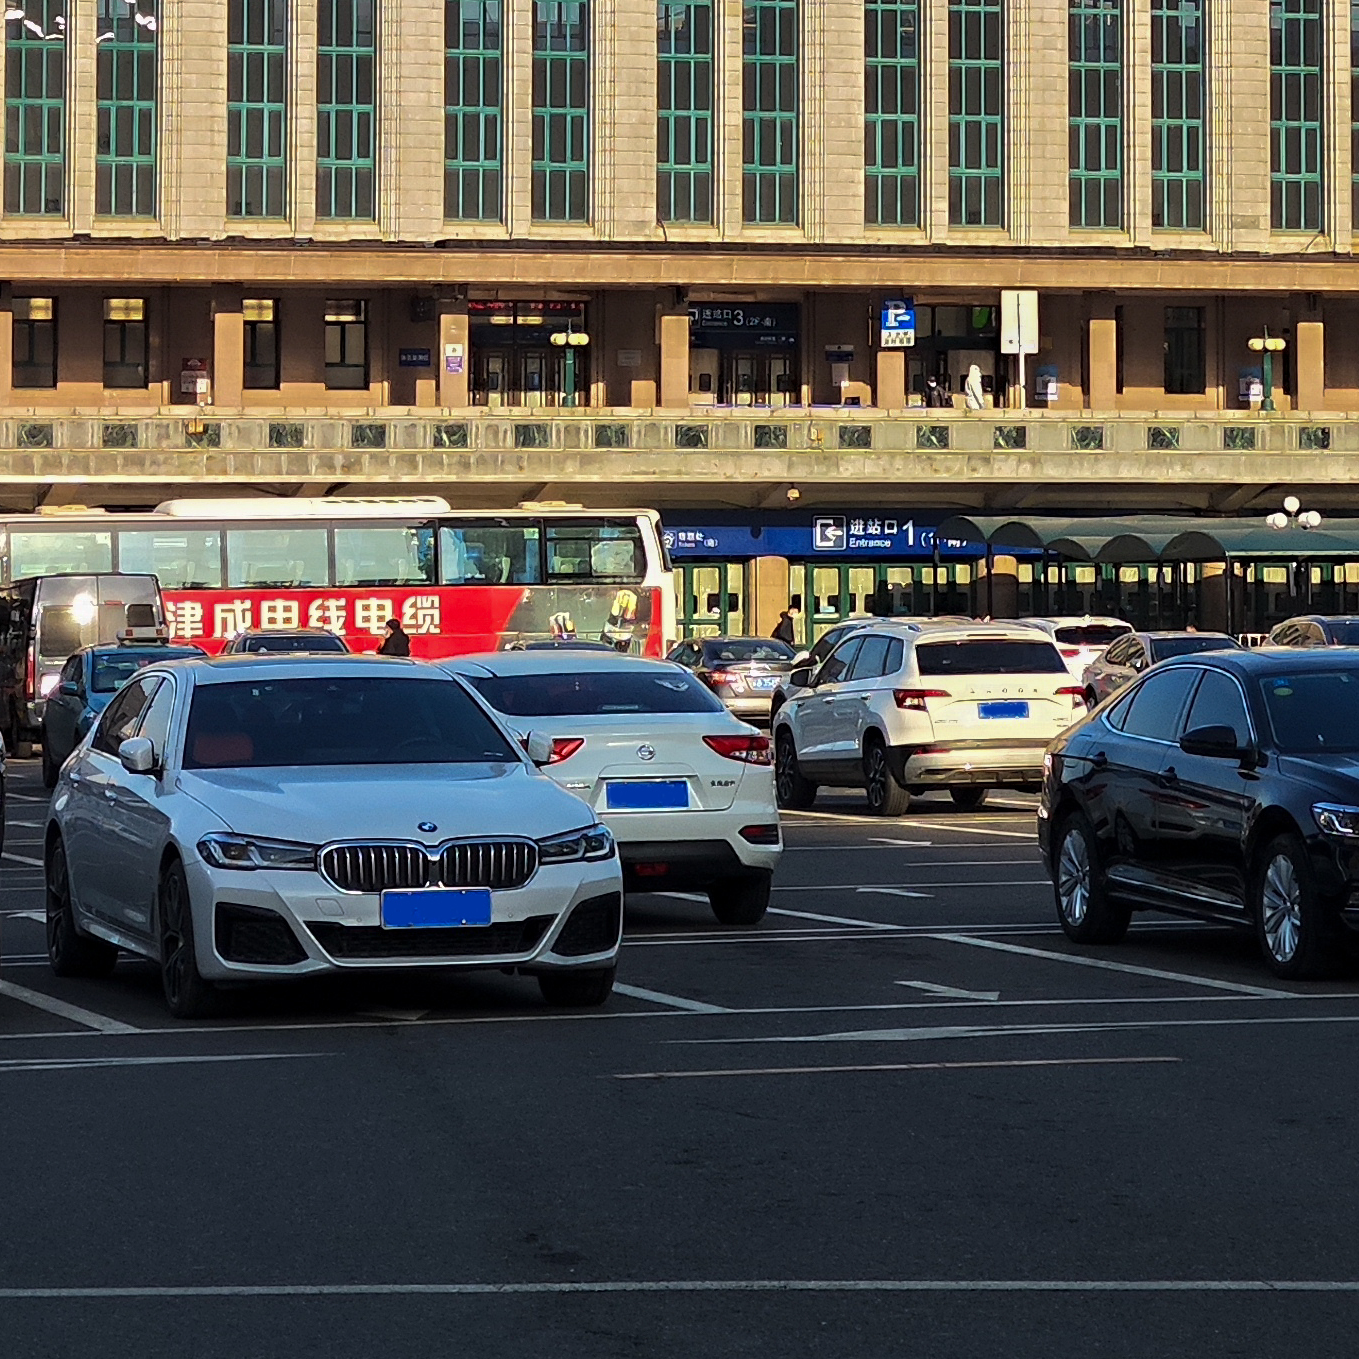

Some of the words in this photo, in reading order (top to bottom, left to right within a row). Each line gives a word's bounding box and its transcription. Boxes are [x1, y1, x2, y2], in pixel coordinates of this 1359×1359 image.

[733, 309, 744, 326] 3
[885, 300, 907, 327] P
[848, 518, 898, 537] 进站口
[901, 519, 914, 547] 1
[848, 536, 892, 548] Entrance
[165, 595, 442, 640] 津成电线电缆
